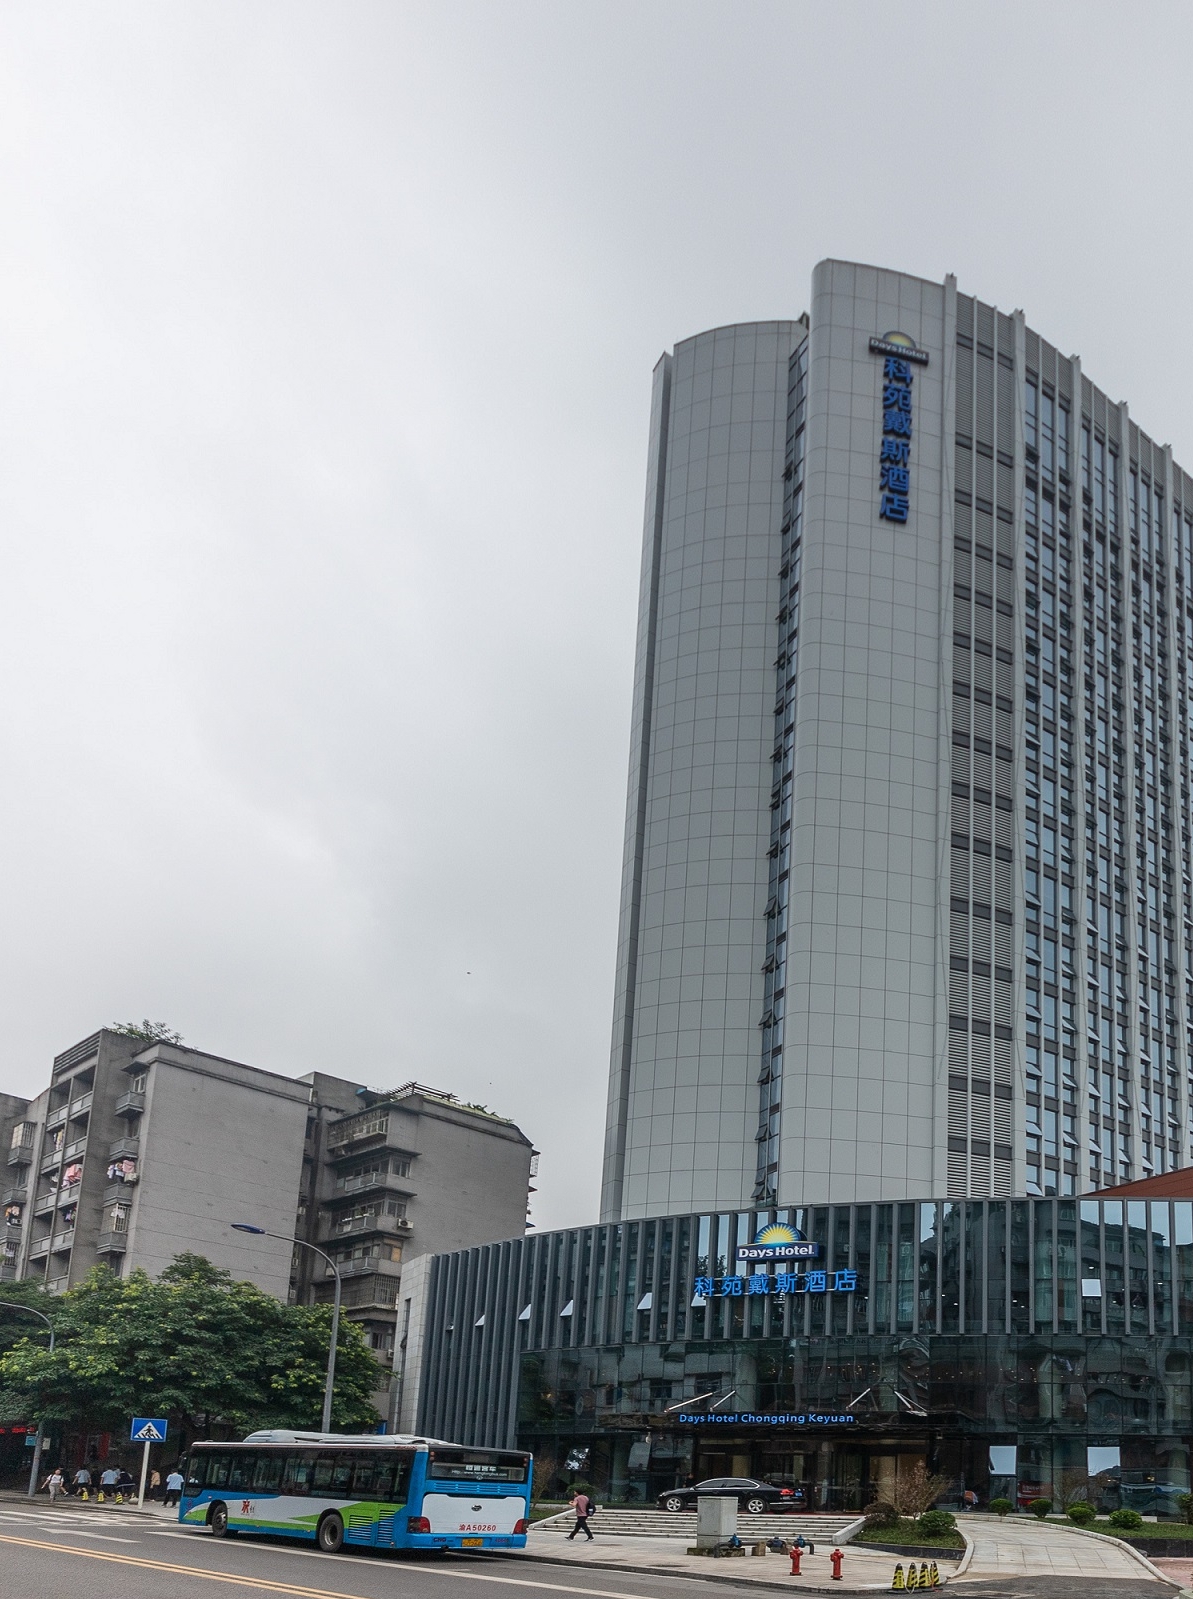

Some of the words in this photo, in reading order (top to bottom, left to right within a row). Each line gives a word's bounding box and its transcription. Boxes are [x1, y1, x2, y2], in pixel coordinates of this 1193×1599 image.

[871, 339, 898, 352] Days
[898, 346, 927, 360] Hotel
[879, 356, 914, 523] 科苑戴斯酒店
[738, 1247, 774, 1259] Days
[775, 1245, 813, 1256] Hotel
[693, 1268, 858, 1297] 科苑戴斯酒店
[679, 1414, 705, 1425] Days
[707, 1413, 738, 1423] Hotel
[740, 1413, 805, 1425] Chongqing
[808, 1413, 854, 1425] Keyuan
